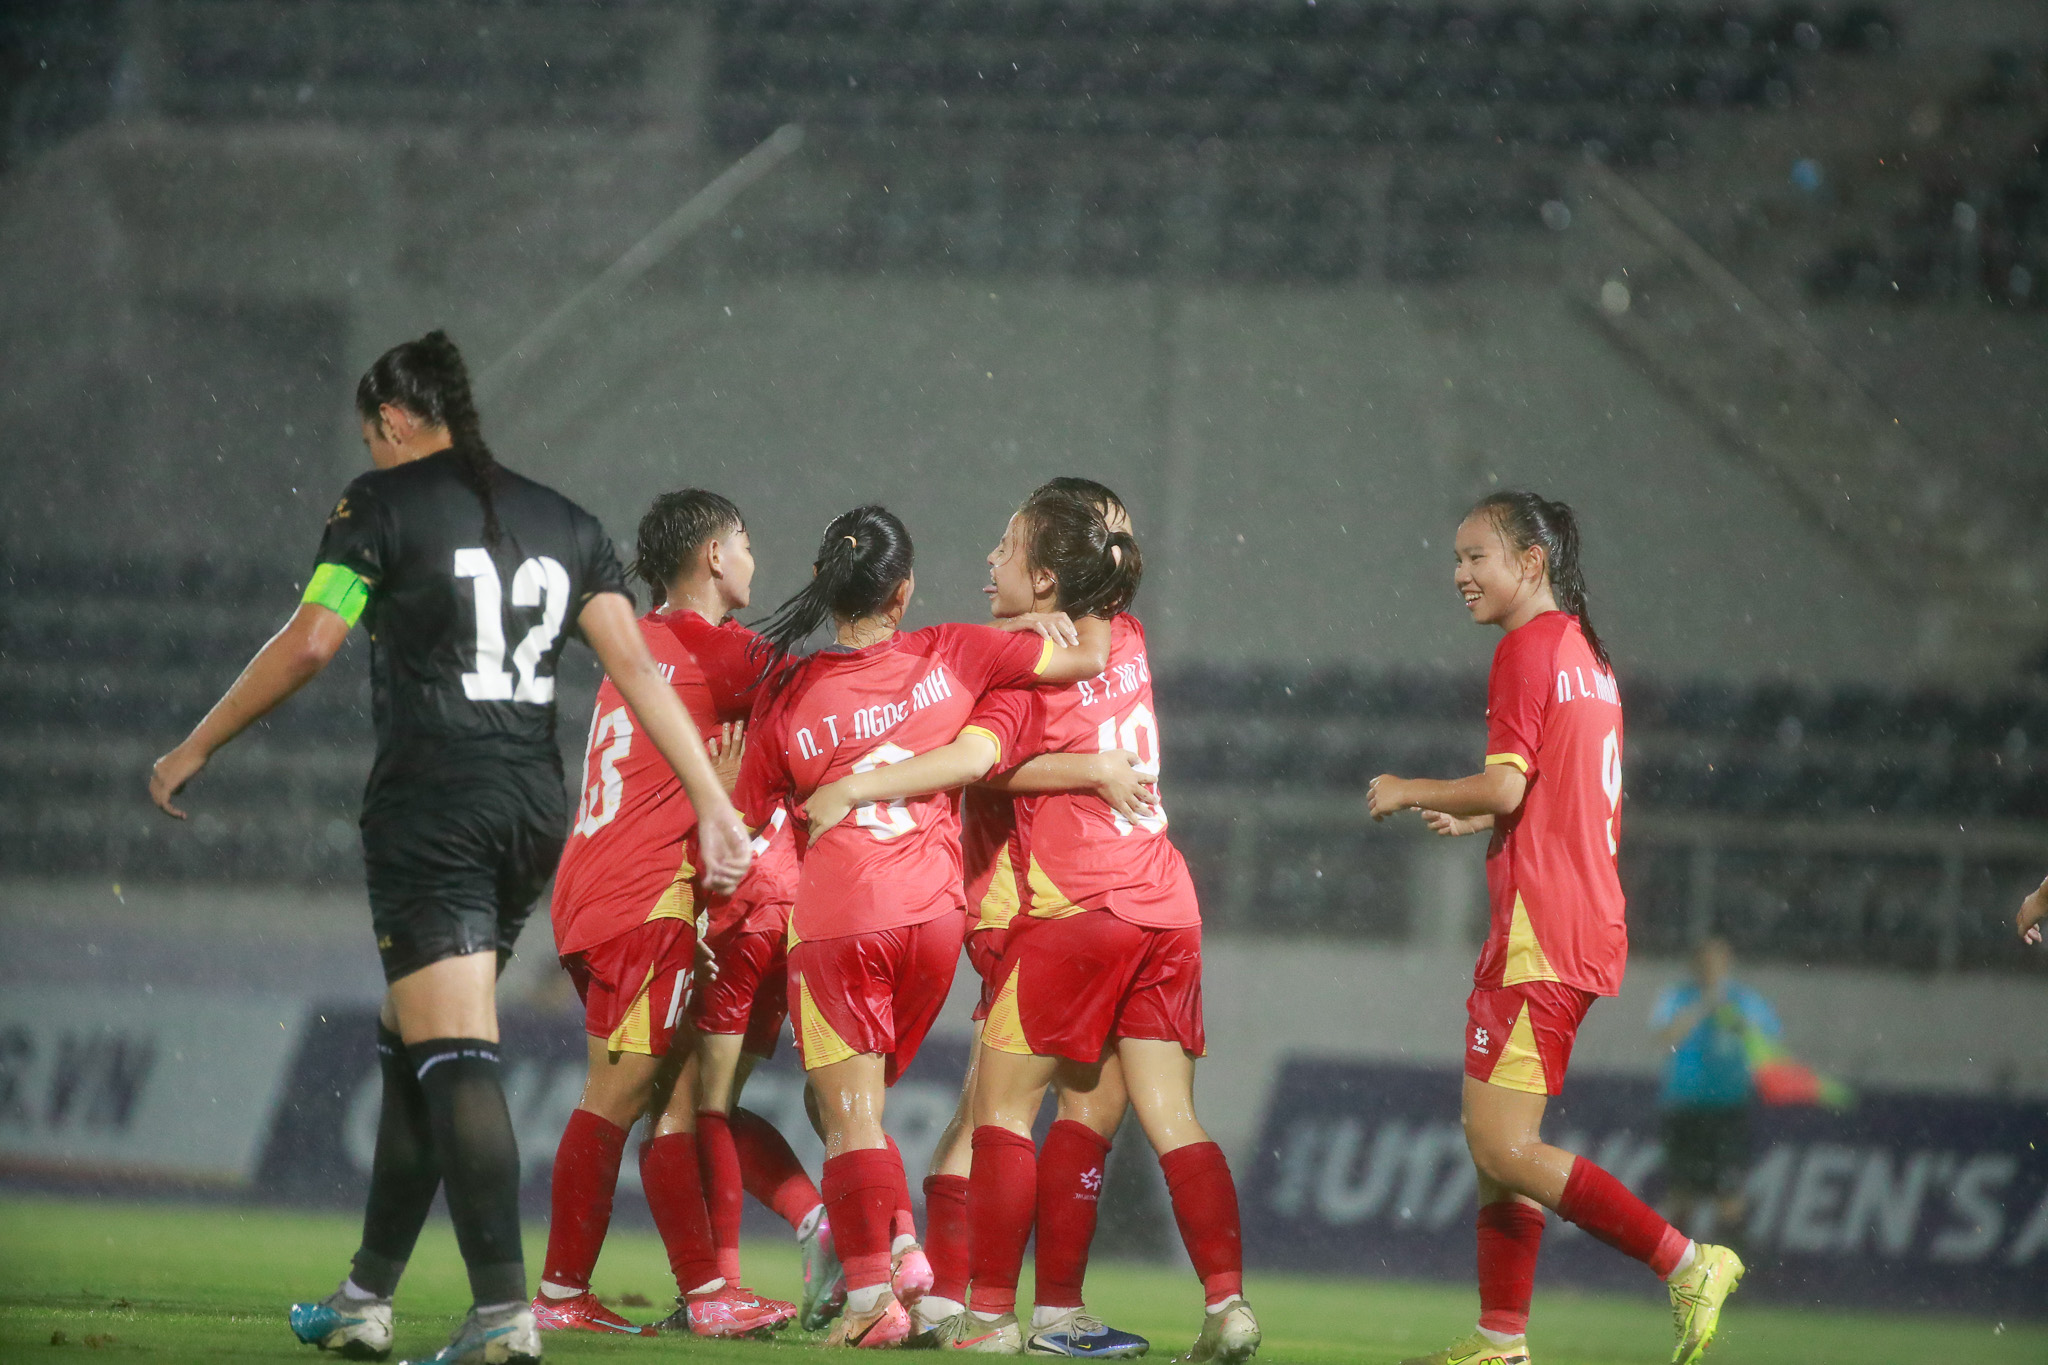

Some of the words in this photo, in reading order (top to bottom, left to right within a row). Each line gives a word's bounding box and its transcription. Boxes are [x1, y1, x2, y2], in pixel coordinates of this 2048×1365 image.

[454, 547, 570, 705] 12
[796, 727, 823, 760] N.
[911, 666, 952, 712] ANH
[1556, 670, 1575, 704] N.
[1576, 666, 1595, 699] L.
[1548, 1130, 2018, 1262] WMEN'S
